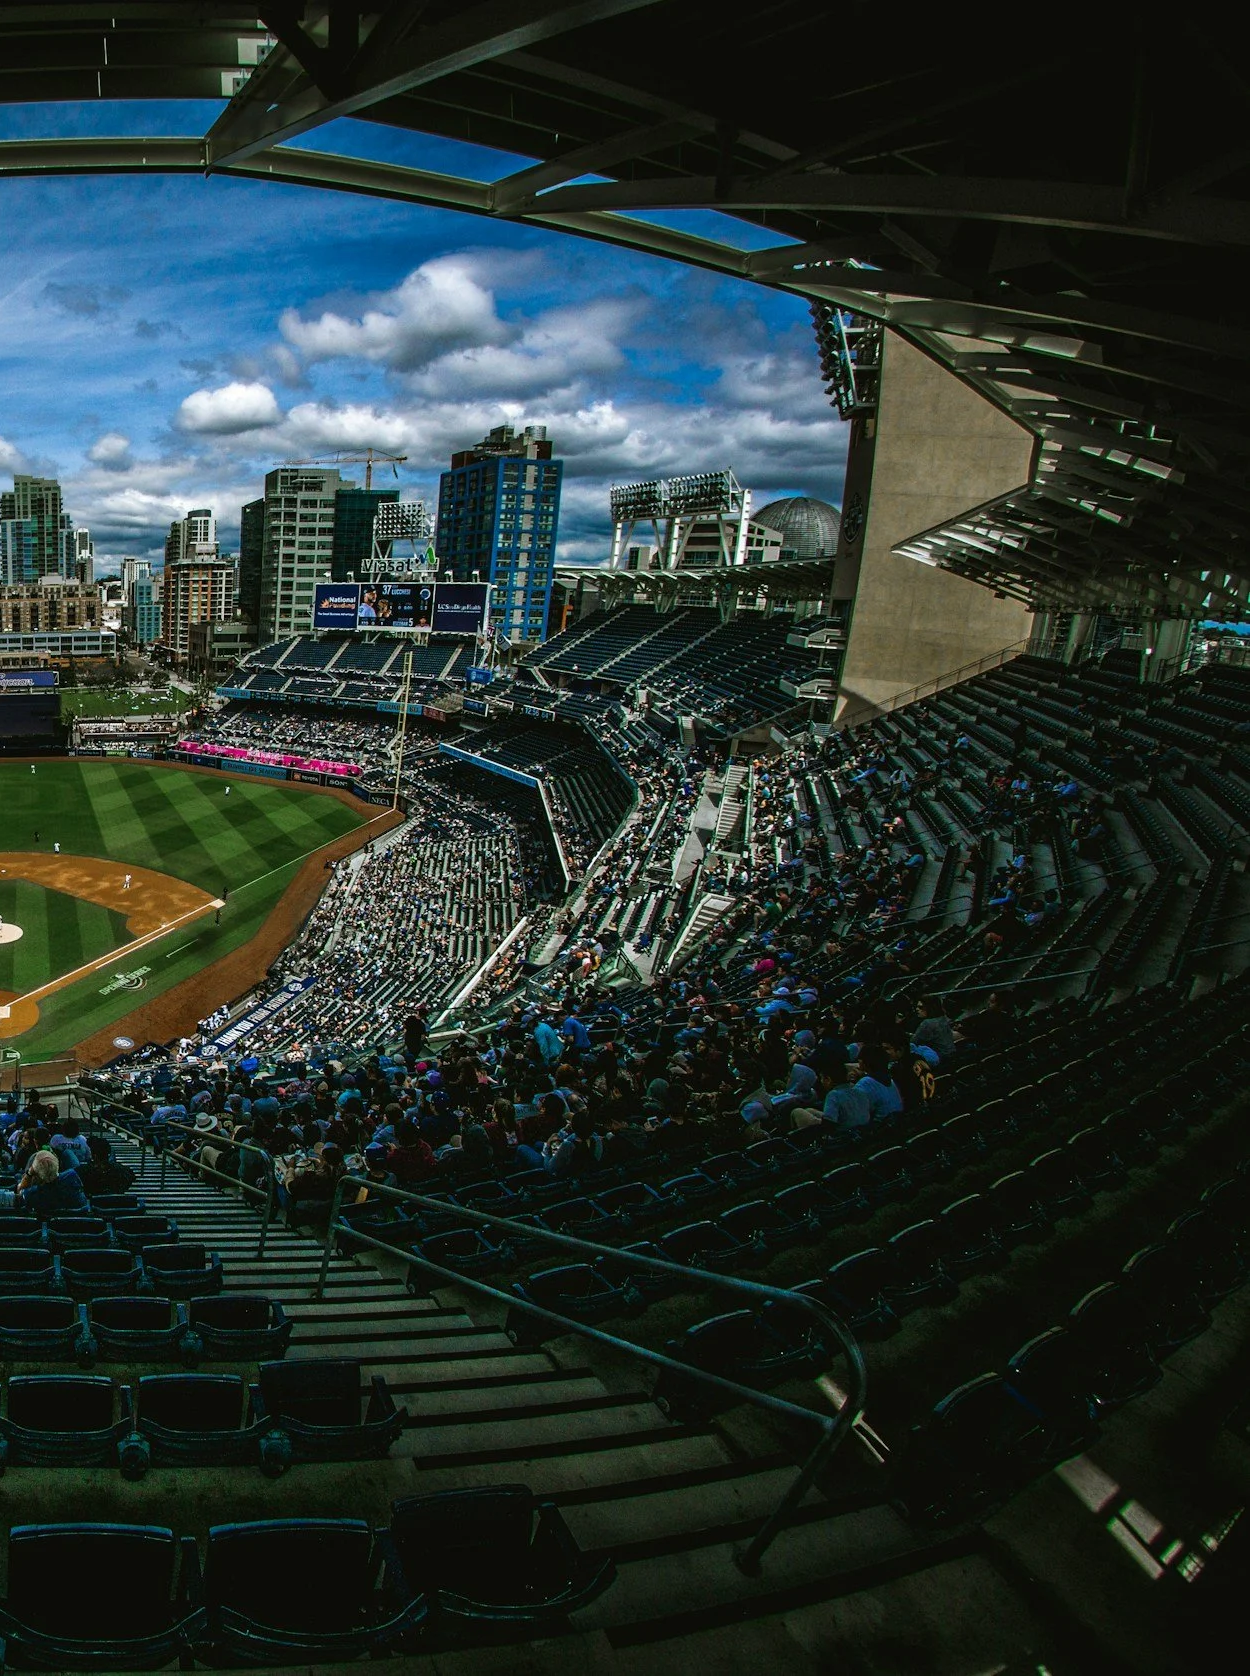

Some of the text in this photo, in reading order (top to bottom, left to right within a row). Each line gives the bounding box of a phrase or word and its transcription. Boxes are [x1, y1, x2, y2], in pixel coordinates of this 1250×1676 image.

[363, 558, 413, 572] Viasat
[382, 585, 392, 595] 37
[409, 618, 413, 626] 5
[259, 766, 286, 776] SEAFOODS
[372, 797, 390, 805] NECA
[99, 966, 151, 995] OPENING SERIES
[214, 991, 294, 1046] THANK YOU FRIAR FAITHFUL
